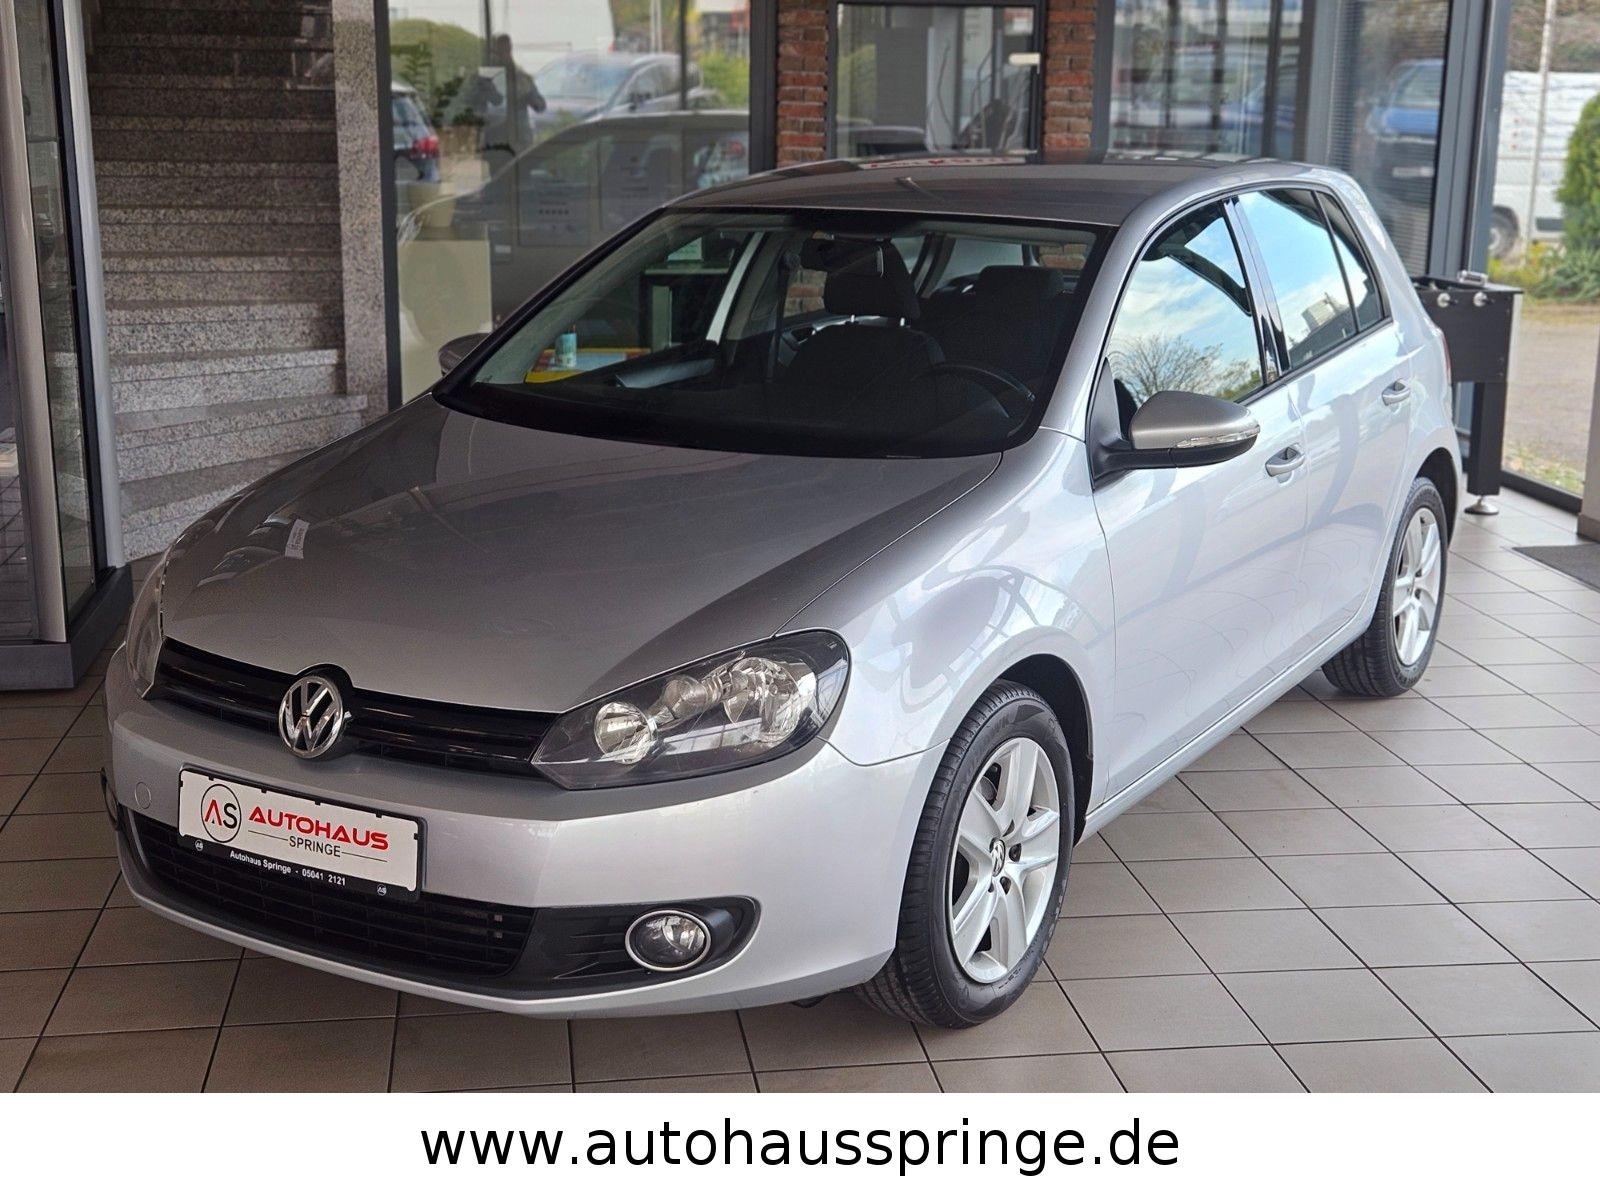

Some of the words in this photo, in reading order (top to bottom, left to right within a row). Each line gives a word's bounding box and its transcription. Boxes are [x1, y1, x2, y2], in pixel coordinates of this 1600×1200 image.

[280, 678, 341, 756] VW
[248, 806, 389, 851] AUTOHAUS
[289, 835, 341, 857] SPRINGE
[230, 850, 262, 866] Autohaus
[263, 859, 291, 874] Springe
[302, 868, 324, 881] 05041
[328, 874, 346, 886] 2121
